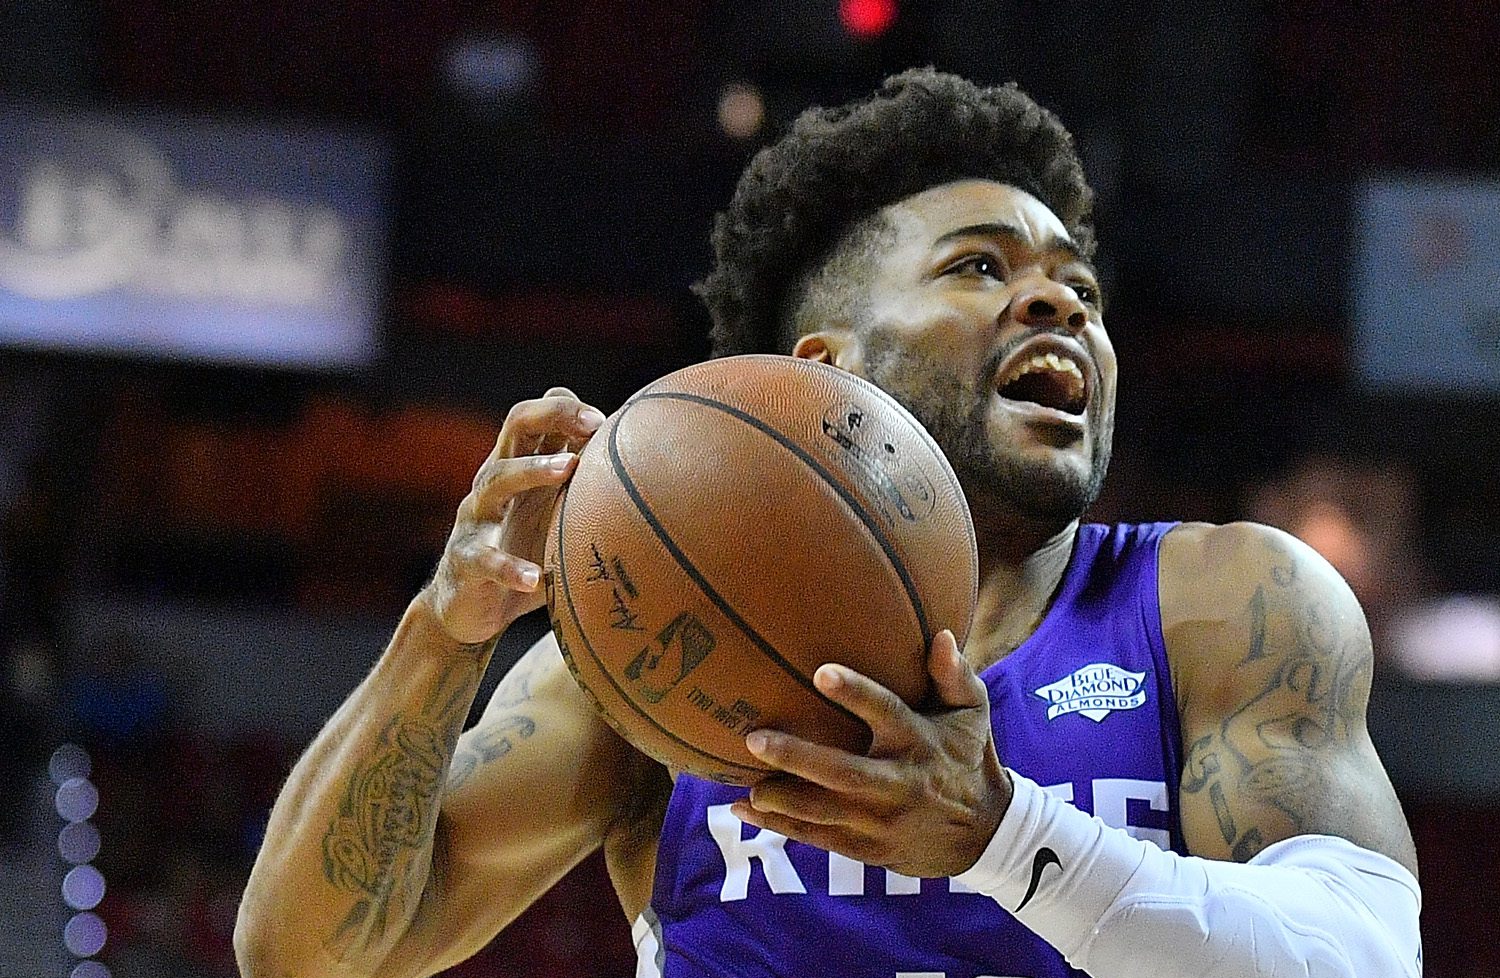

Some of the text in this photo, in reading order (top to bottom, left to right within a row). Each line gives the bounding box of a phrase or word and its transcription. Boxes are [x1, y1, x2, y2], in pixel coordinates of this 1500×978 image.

[1070, 667, 1117, 688] BLUE
[1047, 677, 1140, 703] DIAMOND
[1056, 698, 1139, 714] ALMONDS
